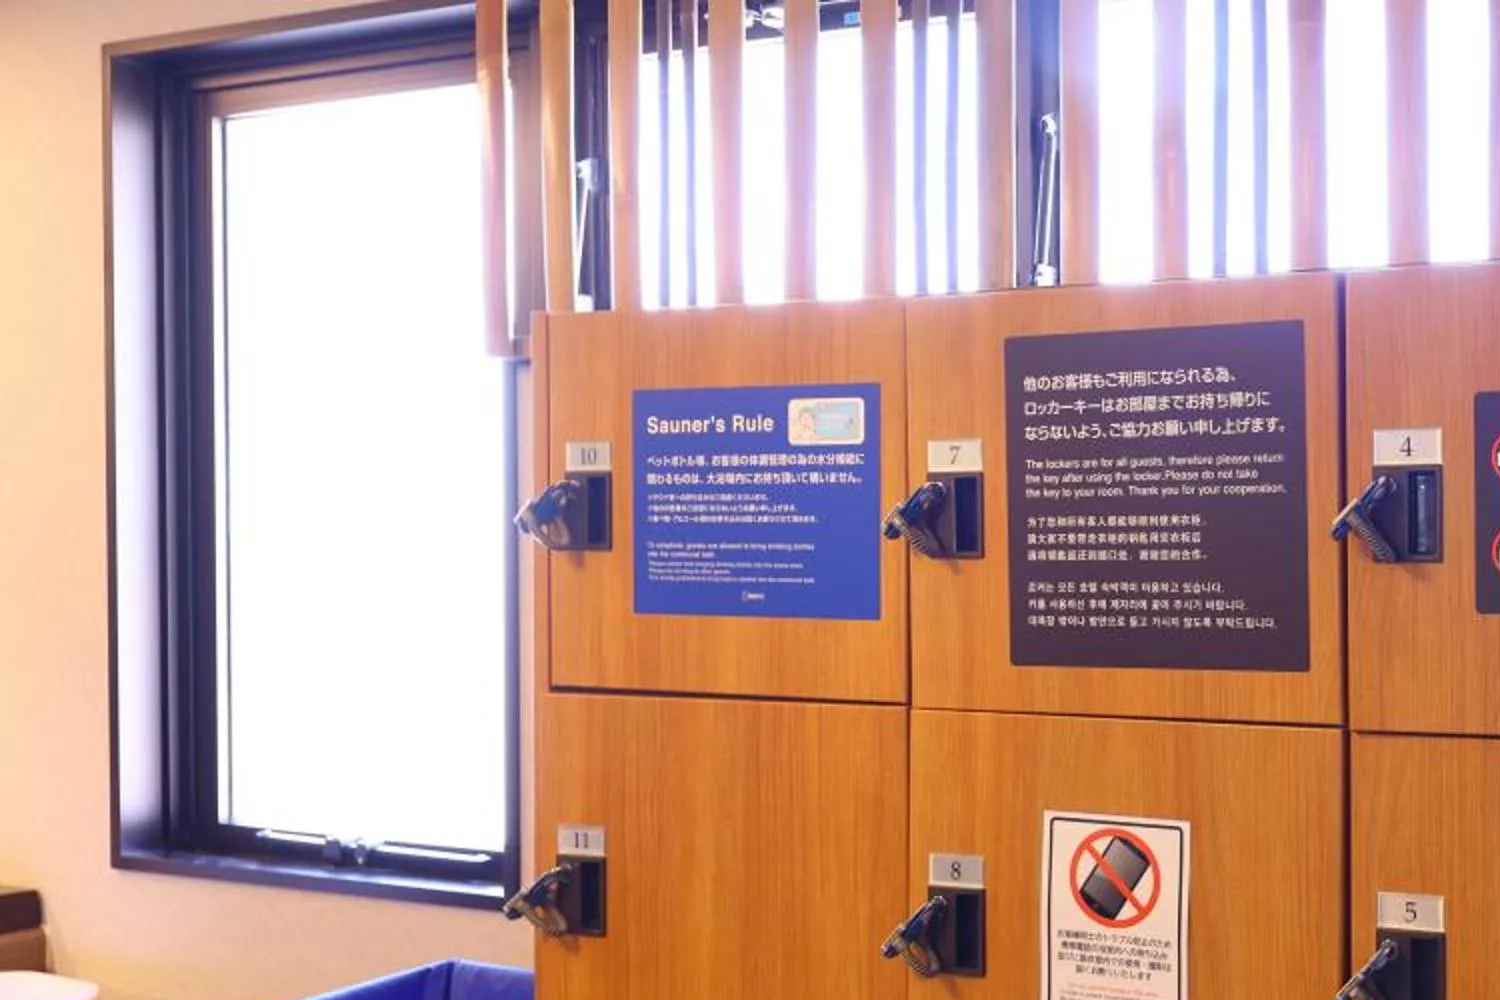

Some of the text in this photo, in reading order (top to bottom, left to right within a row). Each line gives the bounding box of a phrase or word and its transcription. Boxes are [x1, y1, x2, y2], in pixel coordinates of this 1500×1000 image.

[647, 414, 774, 434] Sauner's Rule
[580, 447, 598, 465] 10
[949, 445, 961, 465] 7
[1399, 436, 1415, 457] 4
[574, 831, 589, 849] 11
[950, 861, 962, 880] 8
[1403, 901, 1418, 922] 5
